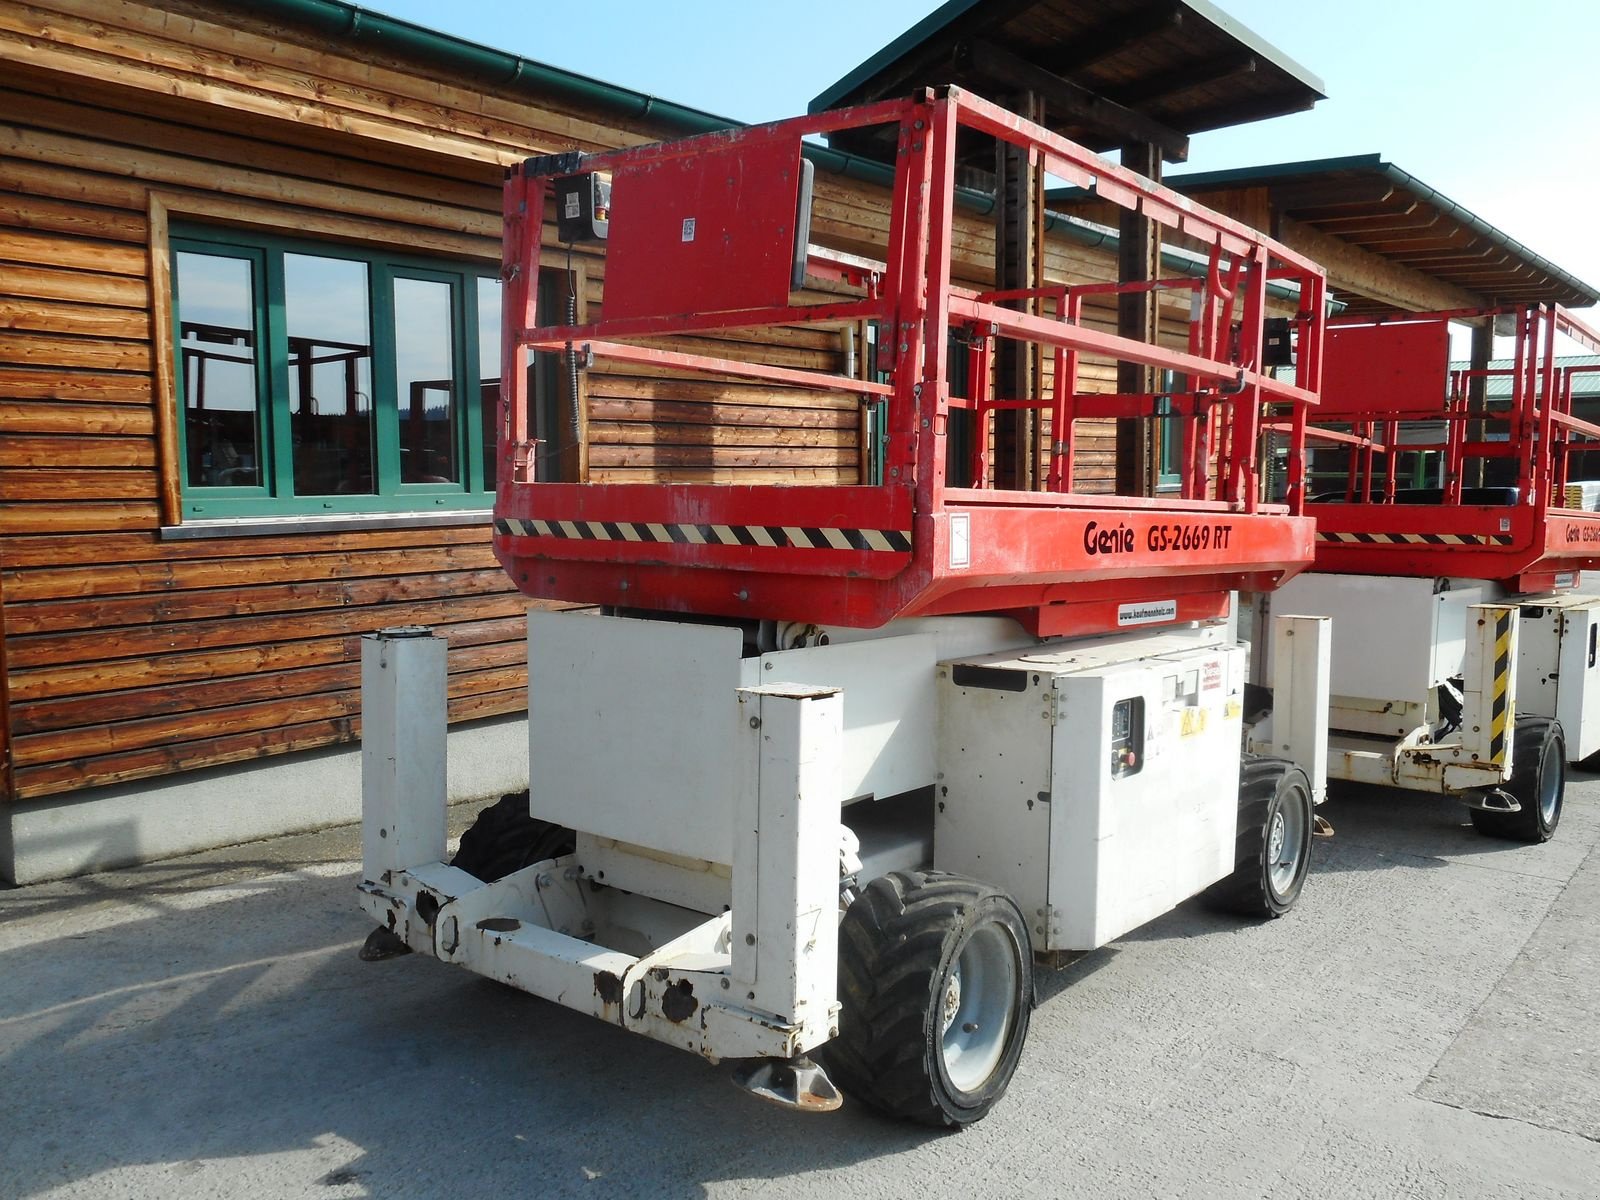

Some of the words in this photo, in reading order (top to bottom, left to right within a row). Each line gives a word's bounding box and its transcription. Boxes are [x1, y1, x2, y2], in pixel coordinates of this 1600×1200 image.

[1084, 520, 1135, 555] Genie
[1147, 525, 1210, 551] GS-2669
[1213, 525, 1232, 549] RT
